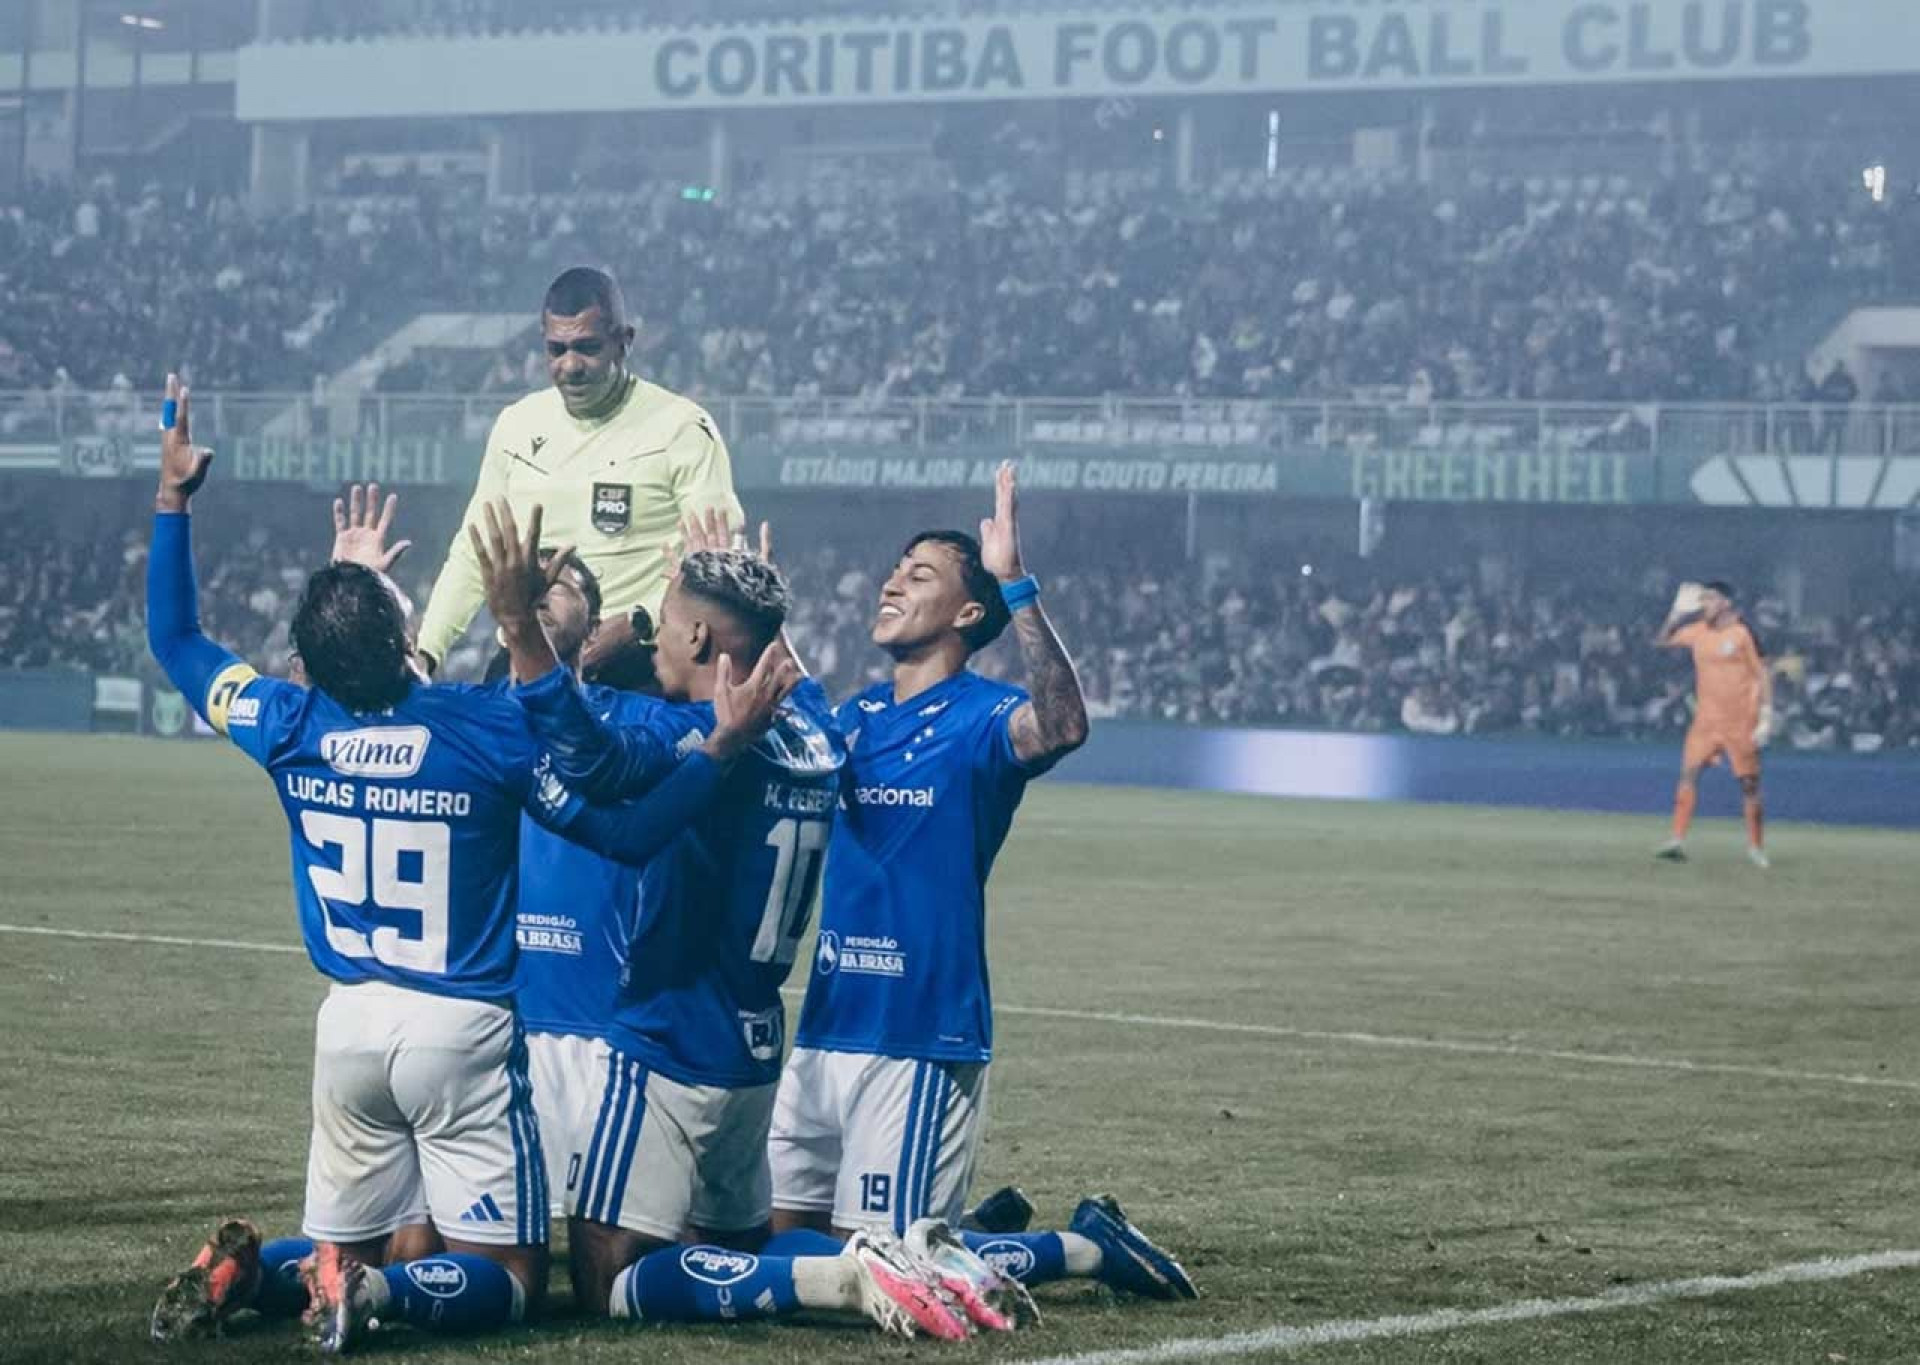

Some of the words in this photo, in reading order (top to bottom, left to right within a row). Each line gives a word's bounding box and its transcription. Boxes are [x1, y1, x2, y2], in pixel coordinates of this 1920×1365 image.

[654, 26, 1024, 98] CORITIBA
[1053, 18, 1277, 87] FOOT
[1306, 7, 1529, 81] BALL
[1562, 0, 1813, 73] CLUB
[234, 437, 353, 480] GREEN
[361, 442, 444, 481] HELL
[780, 451, 876, 486] ESTÁDIO
[881, 458, 966, 487] MAJOR
[967, 454, 1078, 490] AÔNIO
[1083, 460, 1166, 490] COUTO
[1171, 462, 1277, 491] PEREIRA
[1352, 454, 1504, 500] GREEN
[1517, 455, 1627, 502] HELL
[597, 501, 625, 513] PRO
[330, 738, 414, 765] Vilma
[287, 773, 355, 808] LUCAS
[365, 785, 471, 817] ROMERO
[854, 783, 934, 807] acional
[301, 810, 450, 973] 29
[860, 1173, 891, 1212] 19
